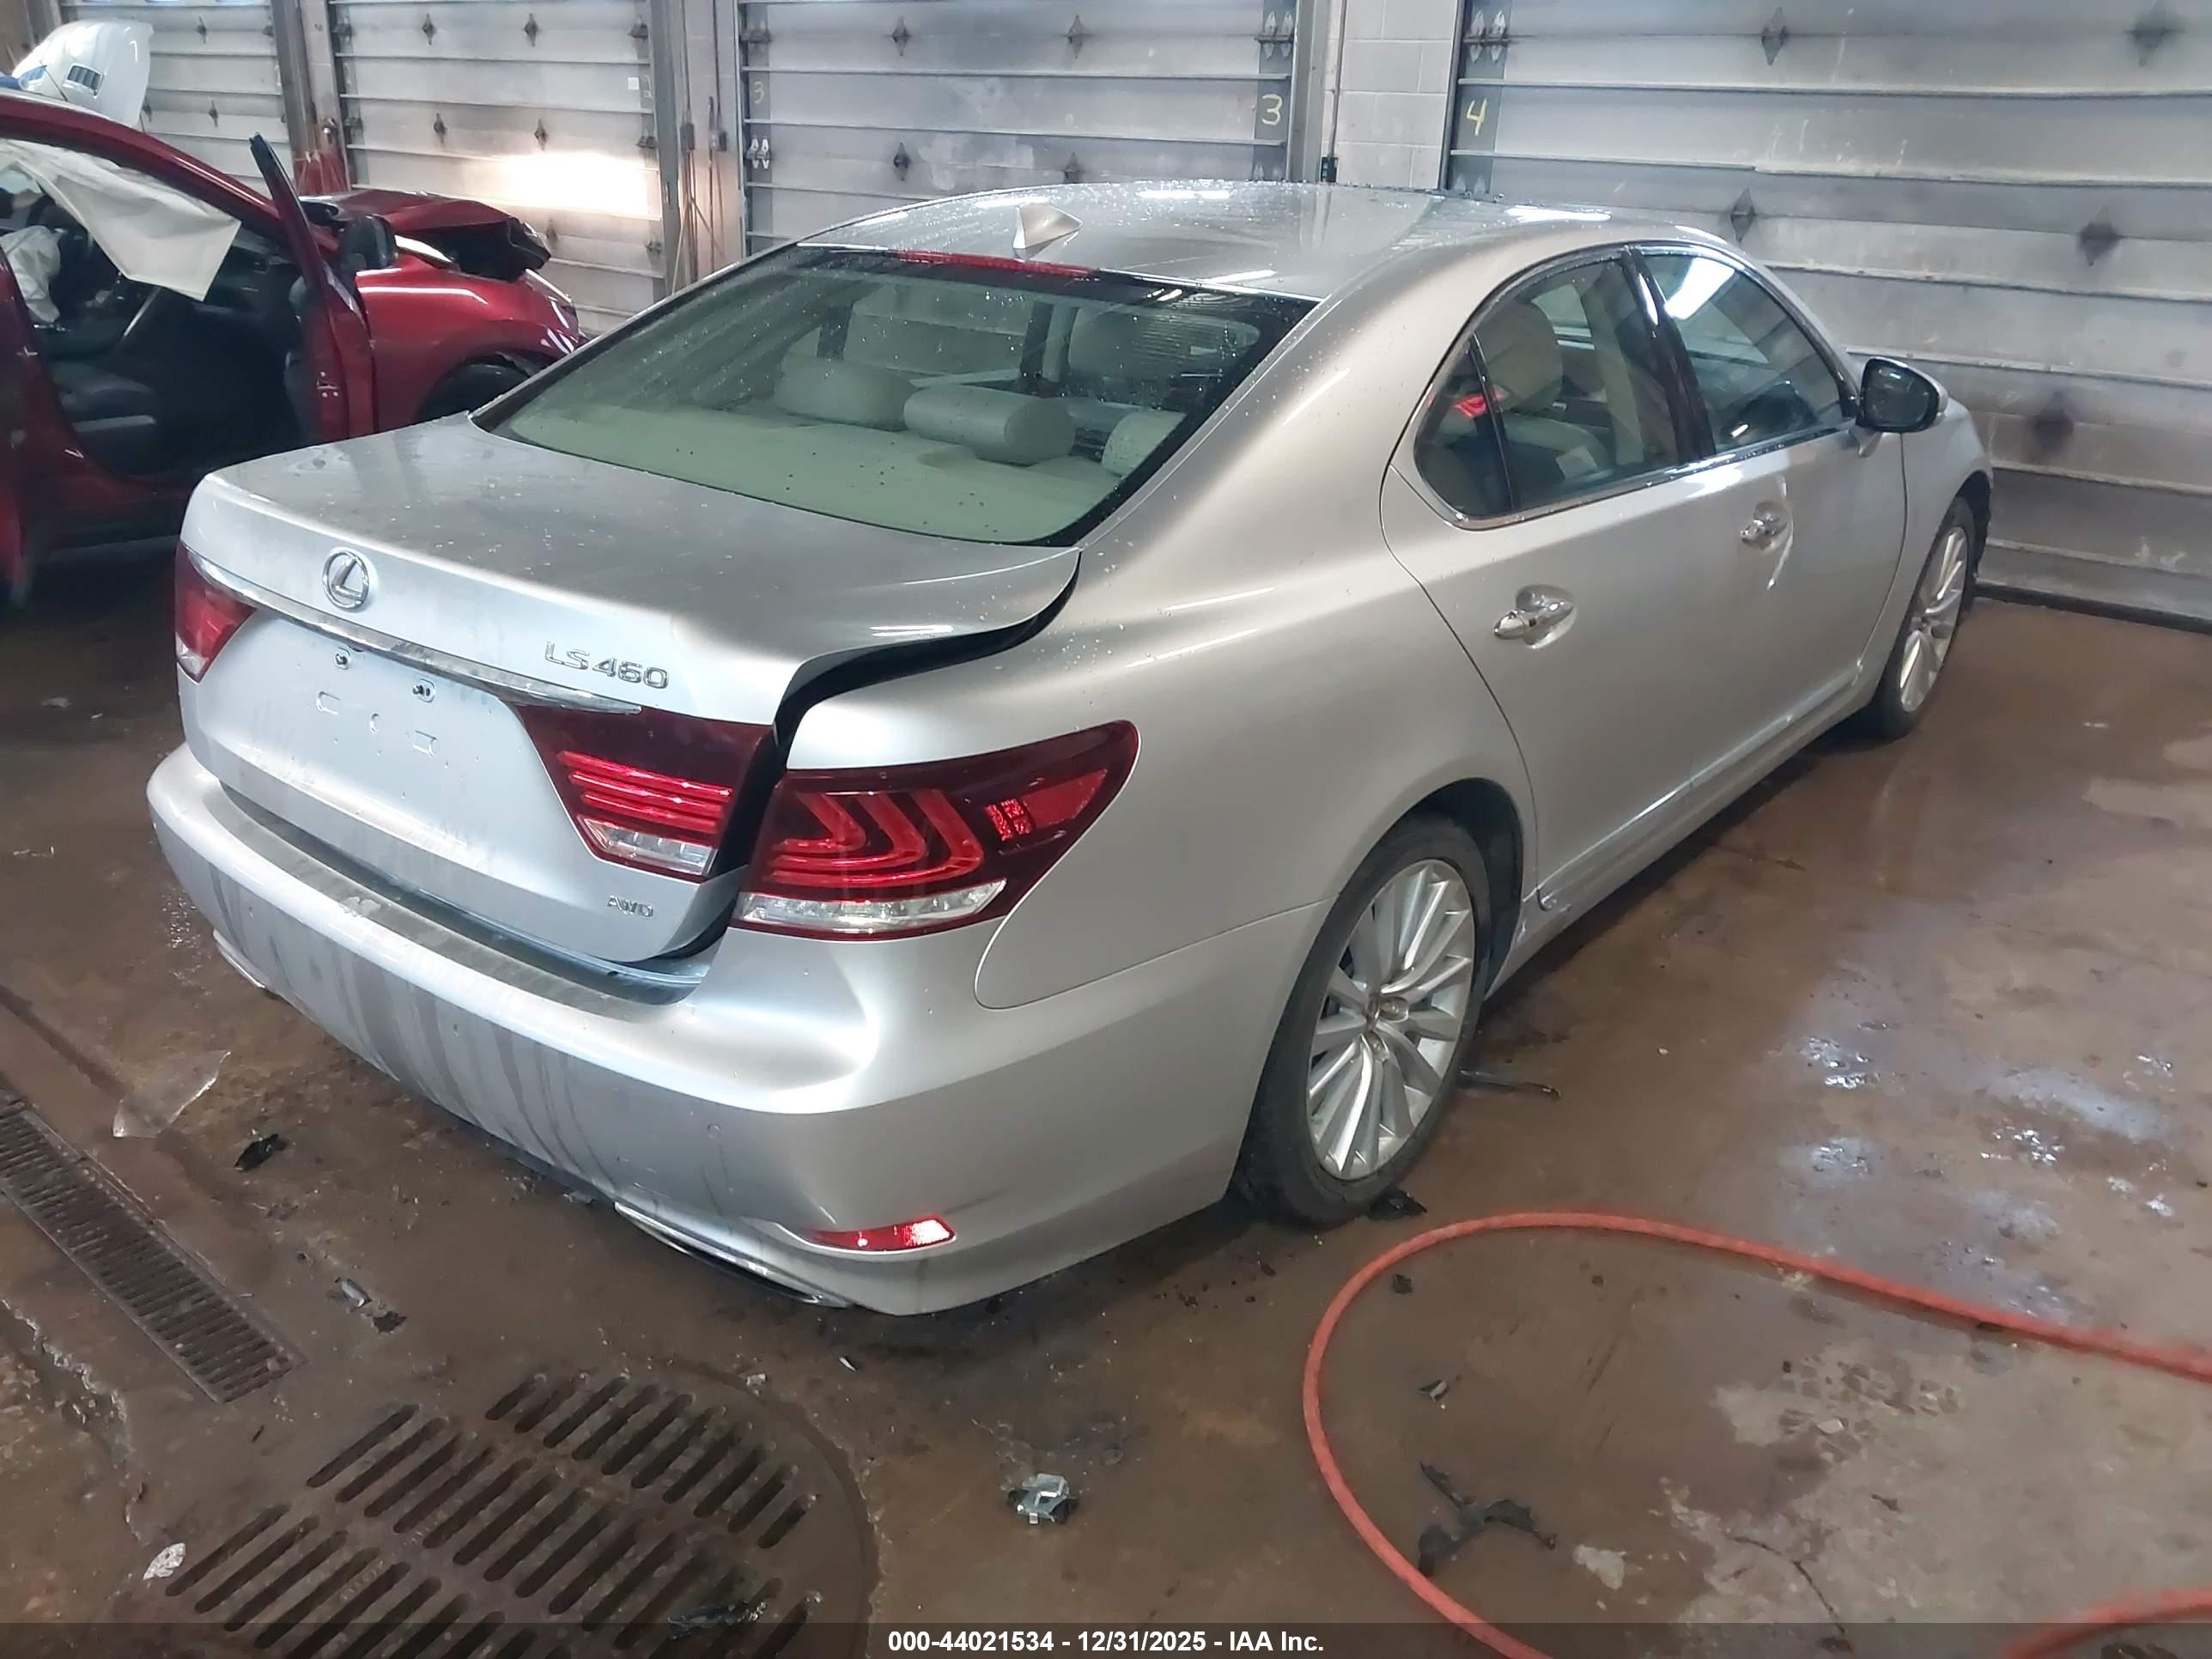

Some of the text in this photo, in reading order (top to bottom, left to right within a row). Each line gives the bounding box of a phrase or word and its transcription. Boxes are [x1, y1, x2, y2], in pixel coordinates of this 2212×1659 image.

[754, 81, 764, 104] 3
[1262, 94, 1283, 125] 3
[1467, 97, 1487, 137] 4
[606, 894, 653, 918] AWD
